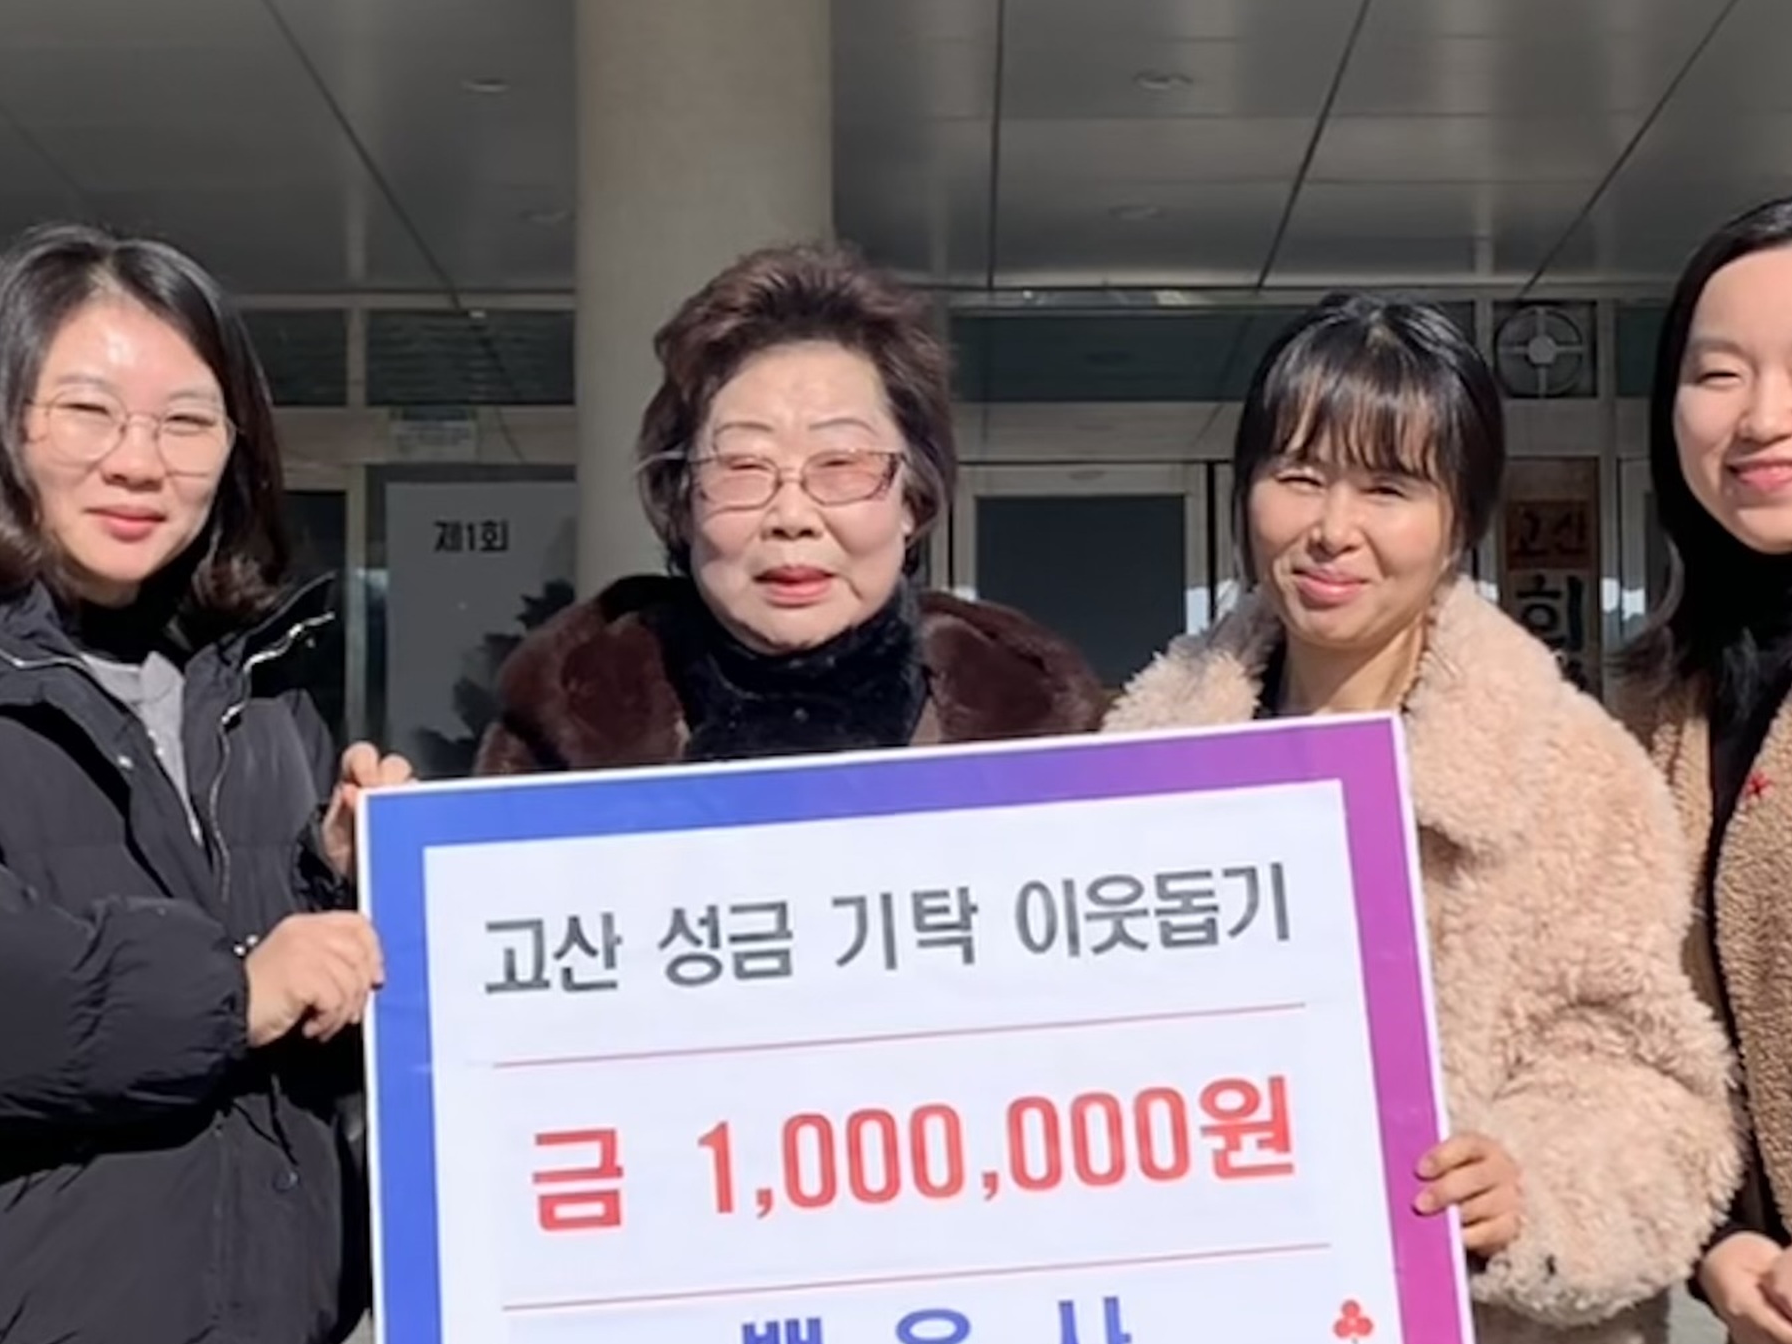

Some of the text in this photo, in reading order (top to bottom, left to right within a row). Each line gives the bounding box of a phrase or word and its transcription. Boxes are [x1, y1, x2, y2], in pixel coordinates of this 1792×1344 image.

[434, 519, 509, 552] 제1회
[483, 860, 1293, 996] 고산 성금 기탁 이웃돕기
[531, 1072, 1296, 1232] 금 1,000,000원
